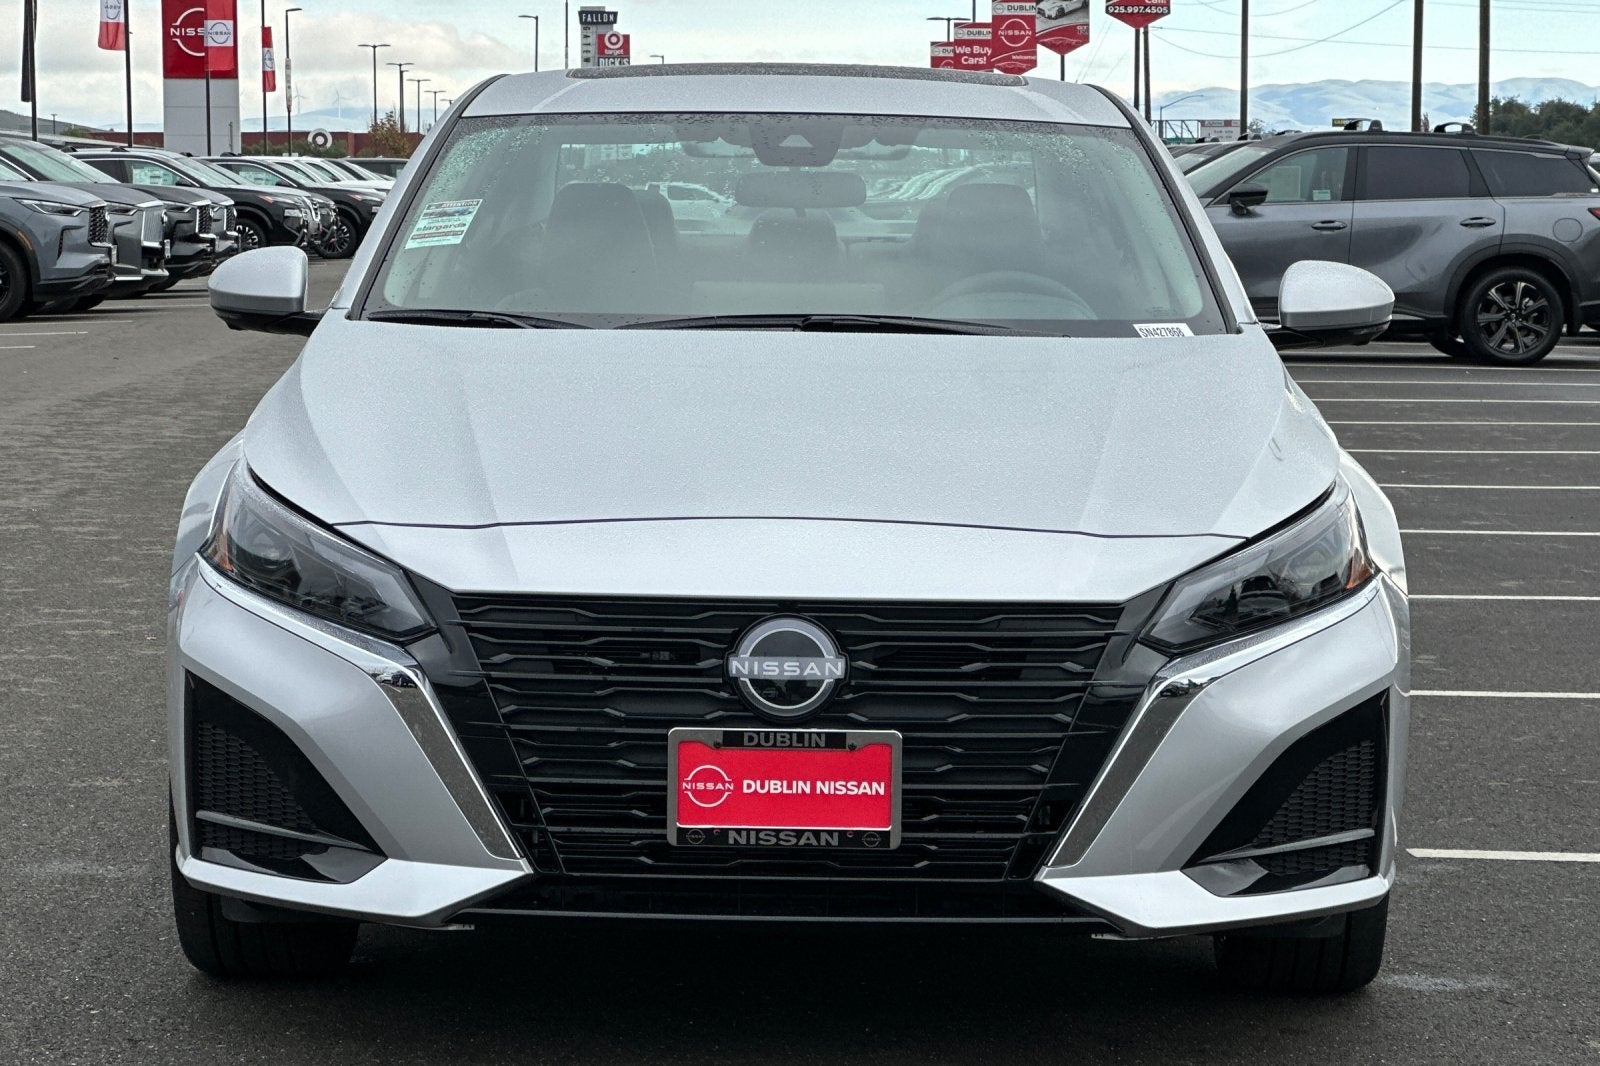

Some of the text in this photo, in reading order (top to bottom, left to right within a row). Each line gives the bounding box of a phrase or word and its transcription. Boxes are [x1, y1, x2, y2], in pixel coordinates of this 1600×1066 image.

[582, 13, 614, 22] FALLON
[955, 46, 992, 56] We Buy
[961, 56, 986, 64] Cars!
[731, 660, 843, 676] NISSAN
[743, 732, 826, 748] DUBLIN
[682, 782, 734, 790] NISSAN
[742, 779, 885, 796] DUBLIN NISSAN
[728, 830, 839, 846] NISSAN
